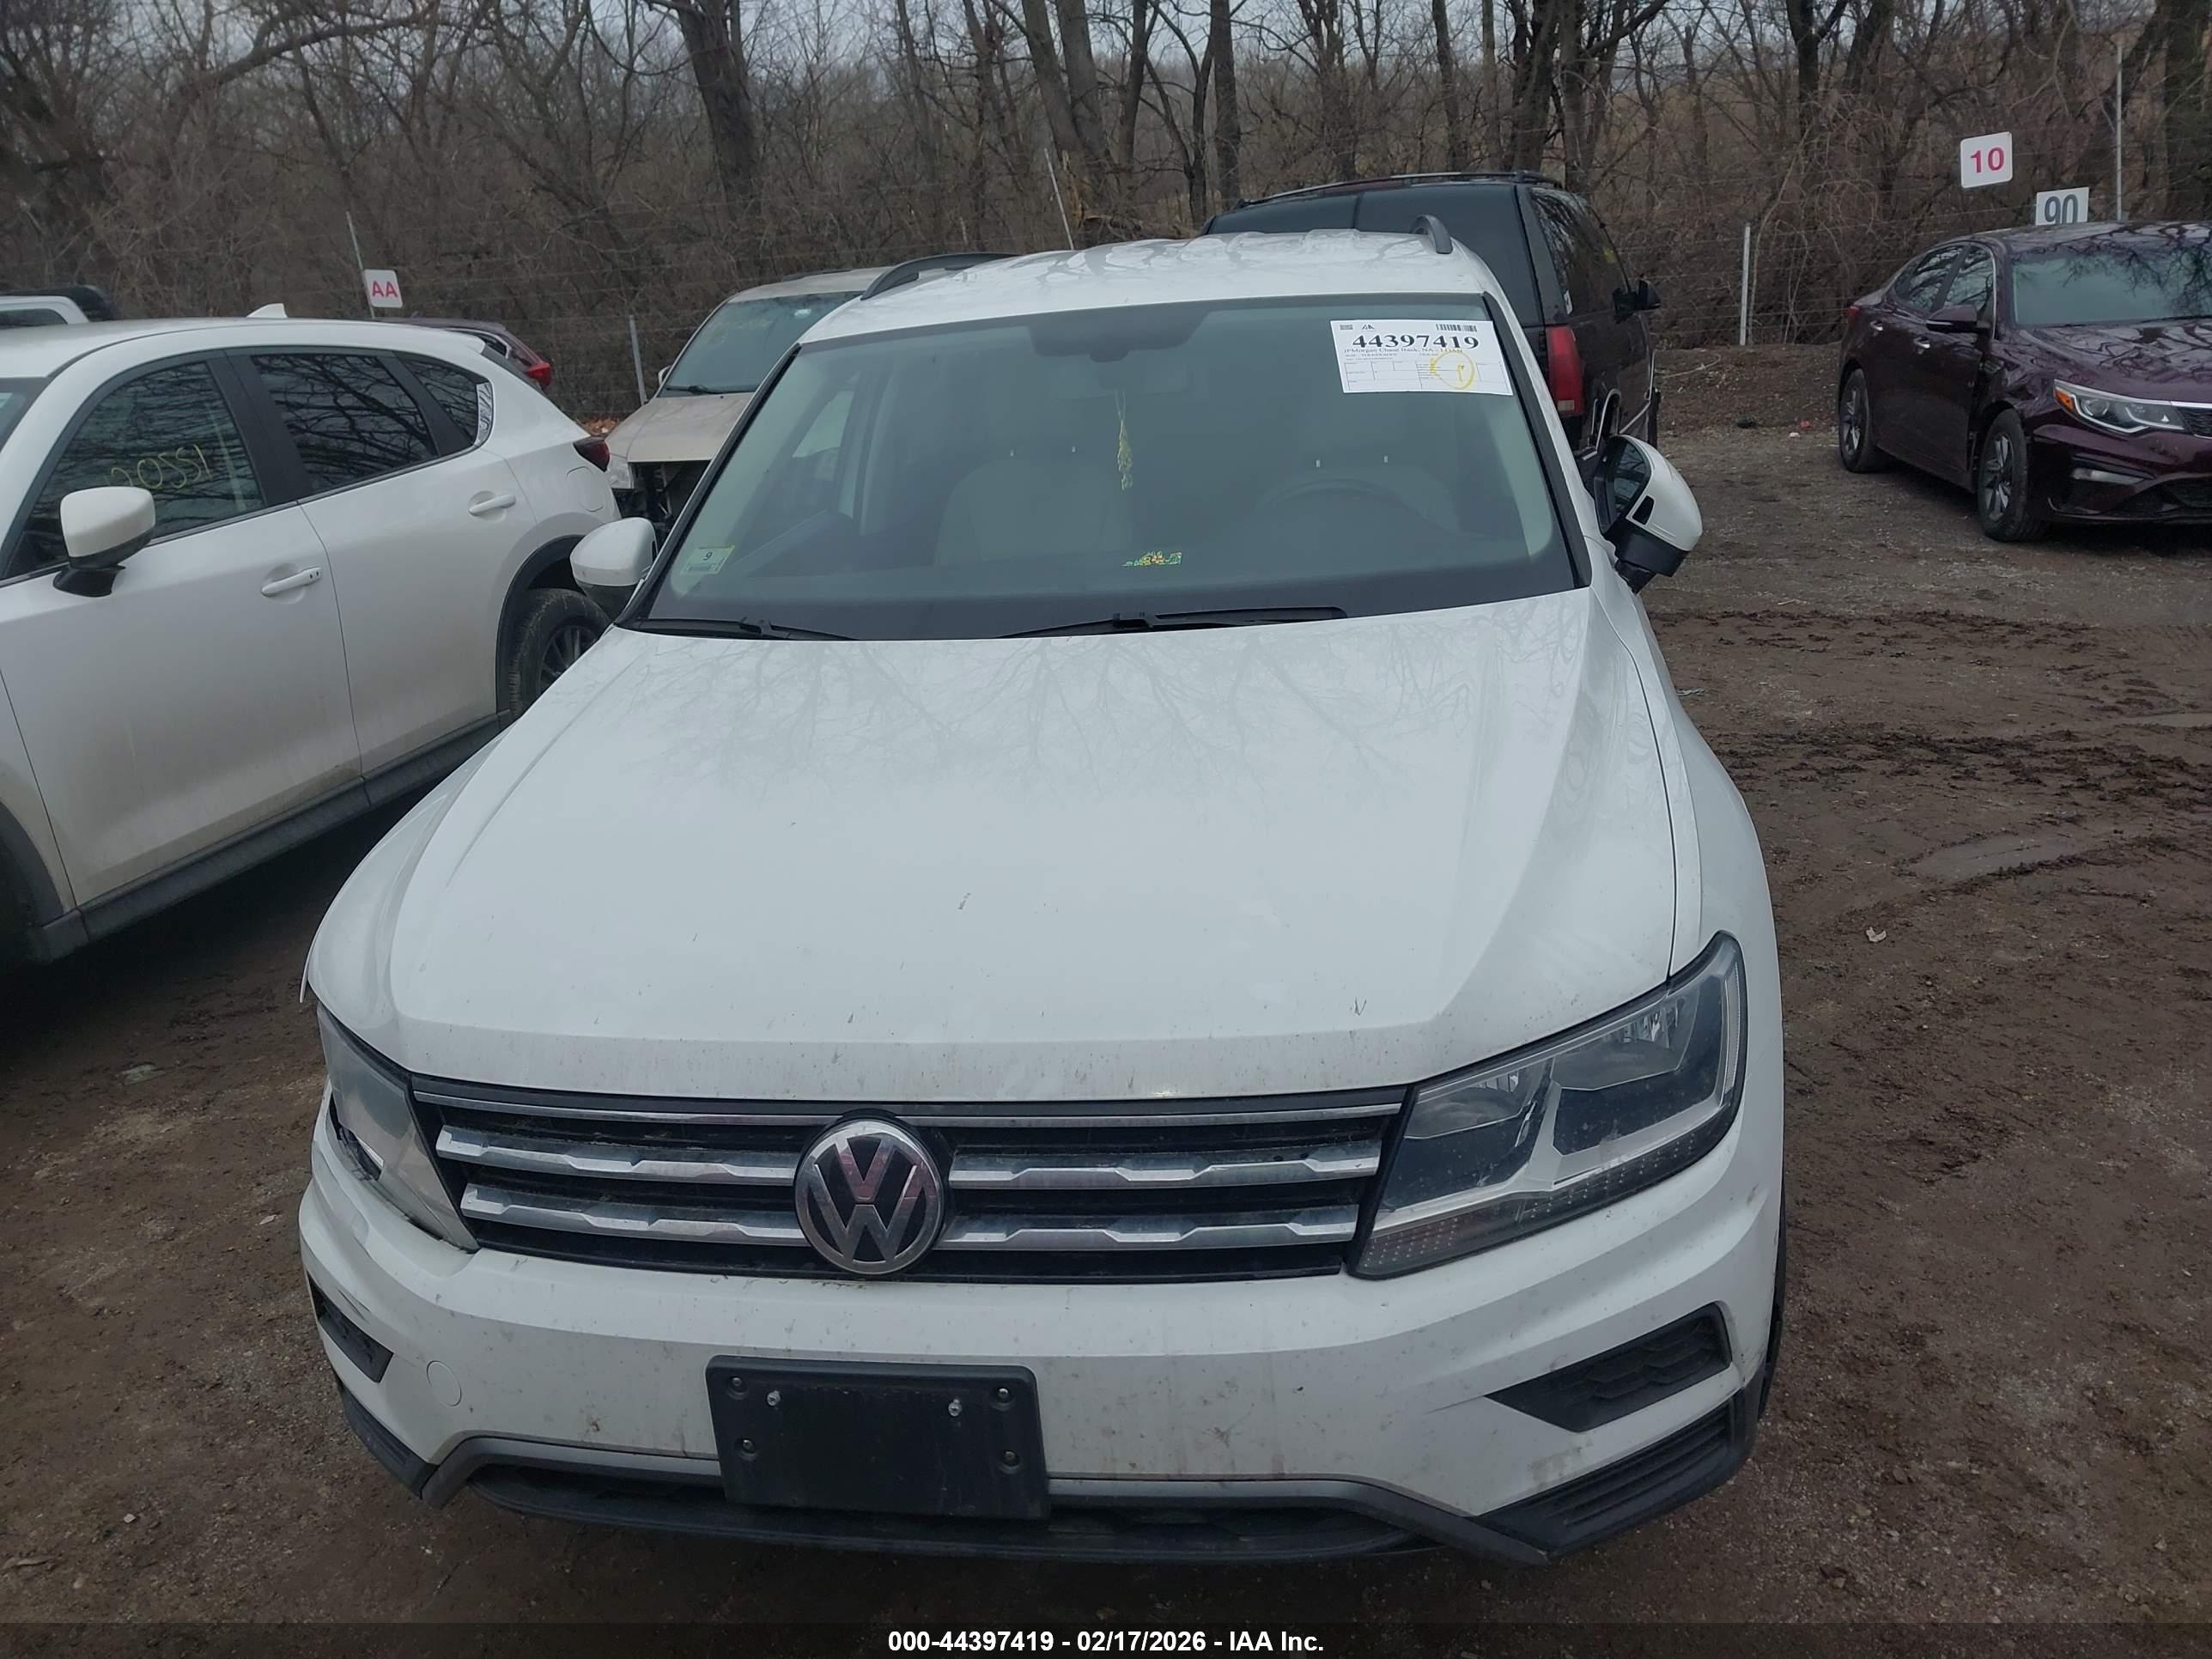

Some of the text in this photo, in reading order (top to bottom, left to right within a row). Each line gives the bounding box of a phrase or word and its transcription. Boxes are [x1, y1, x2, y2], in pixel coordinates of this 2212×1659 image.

[1970, 147, 2005, 173] 10
[2044, 193, 2079, 225] 90
[372, 280, 398, 297] AA
[1352, 334, 1480, 349] 44397419
